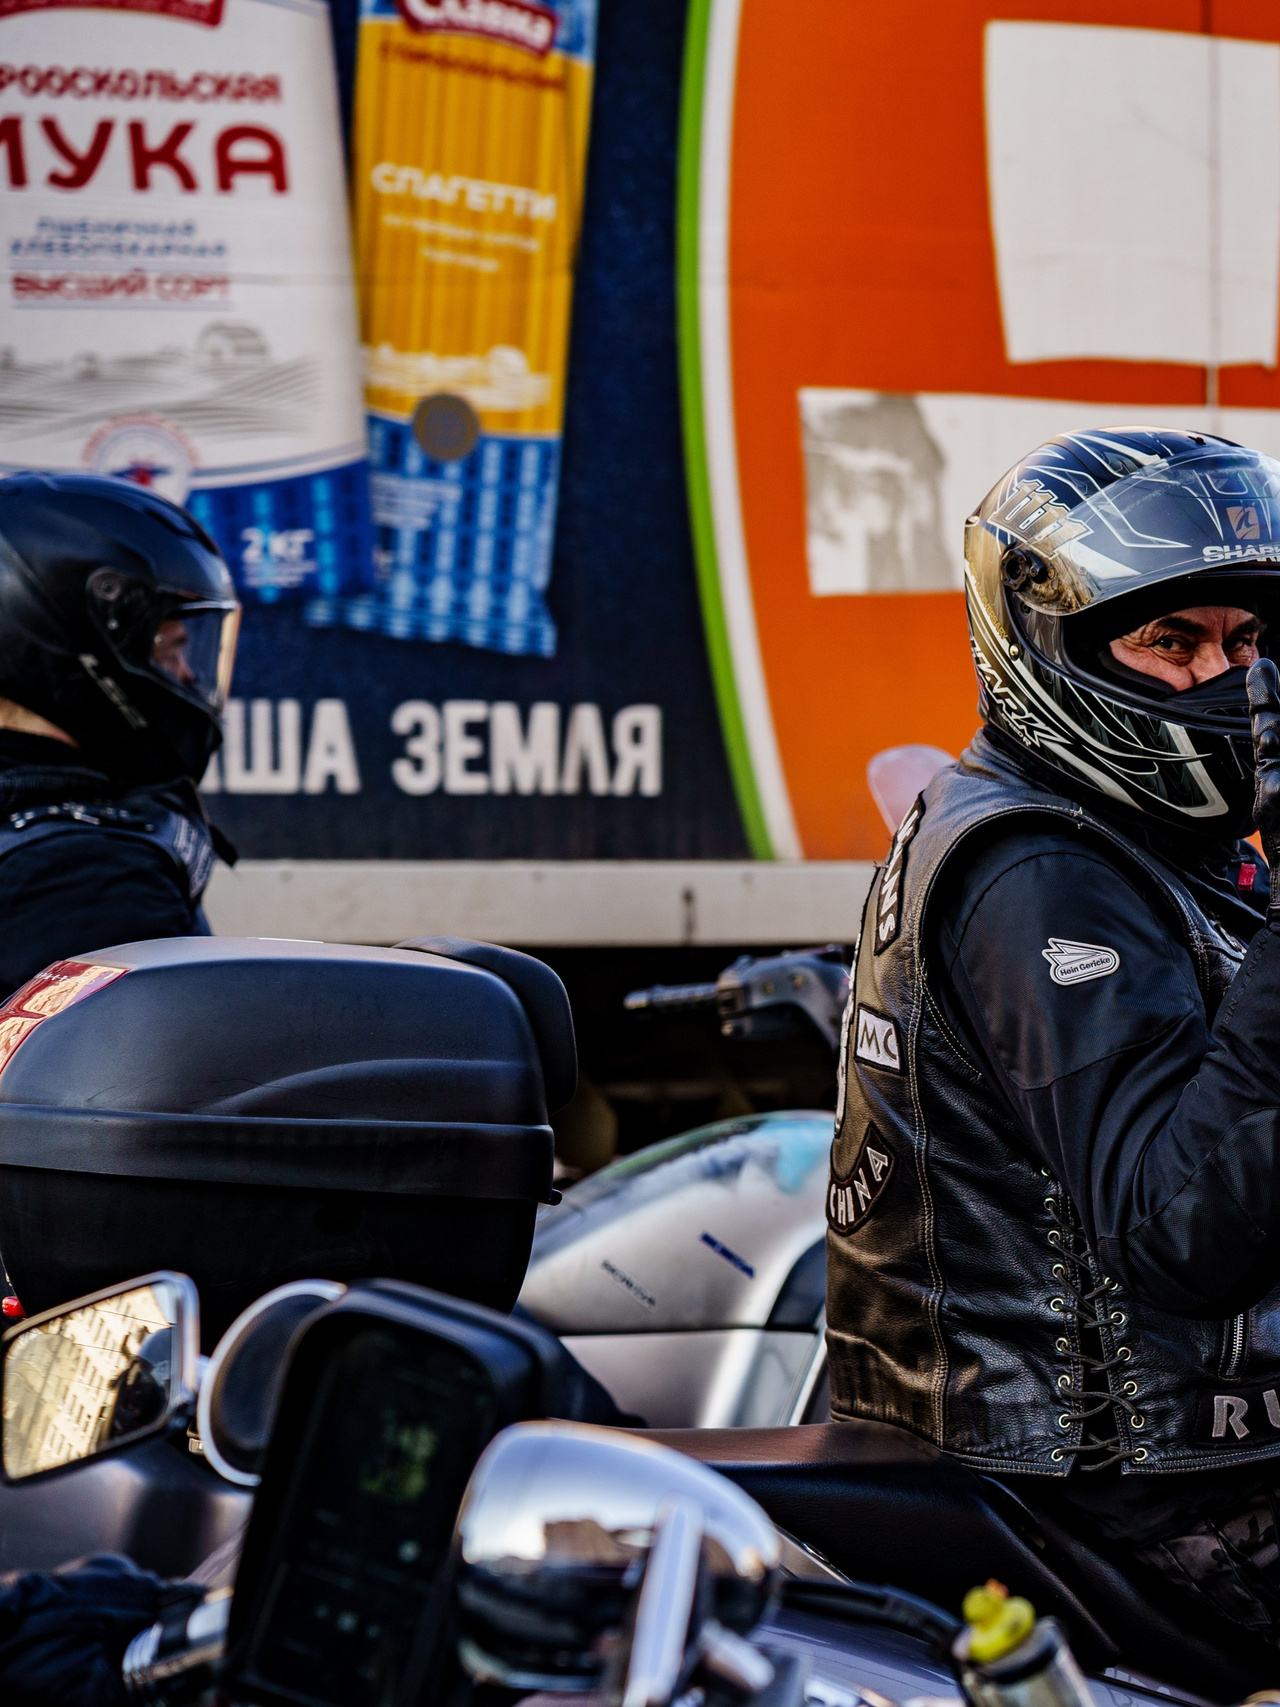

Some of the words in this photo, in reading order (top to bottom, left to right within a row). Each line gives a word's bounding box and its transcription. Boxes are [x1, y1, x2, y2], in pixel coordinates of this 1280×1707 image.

[371, 162, 557, 223] СПАГЕТТИ
[391, 699, 663, 797] ЗЕМЛЯ
[1060, 966, 1080, 977] Hein
[1080, 957, 1111, 971] Gericke
[859, 1018, 897, 1061] MC
